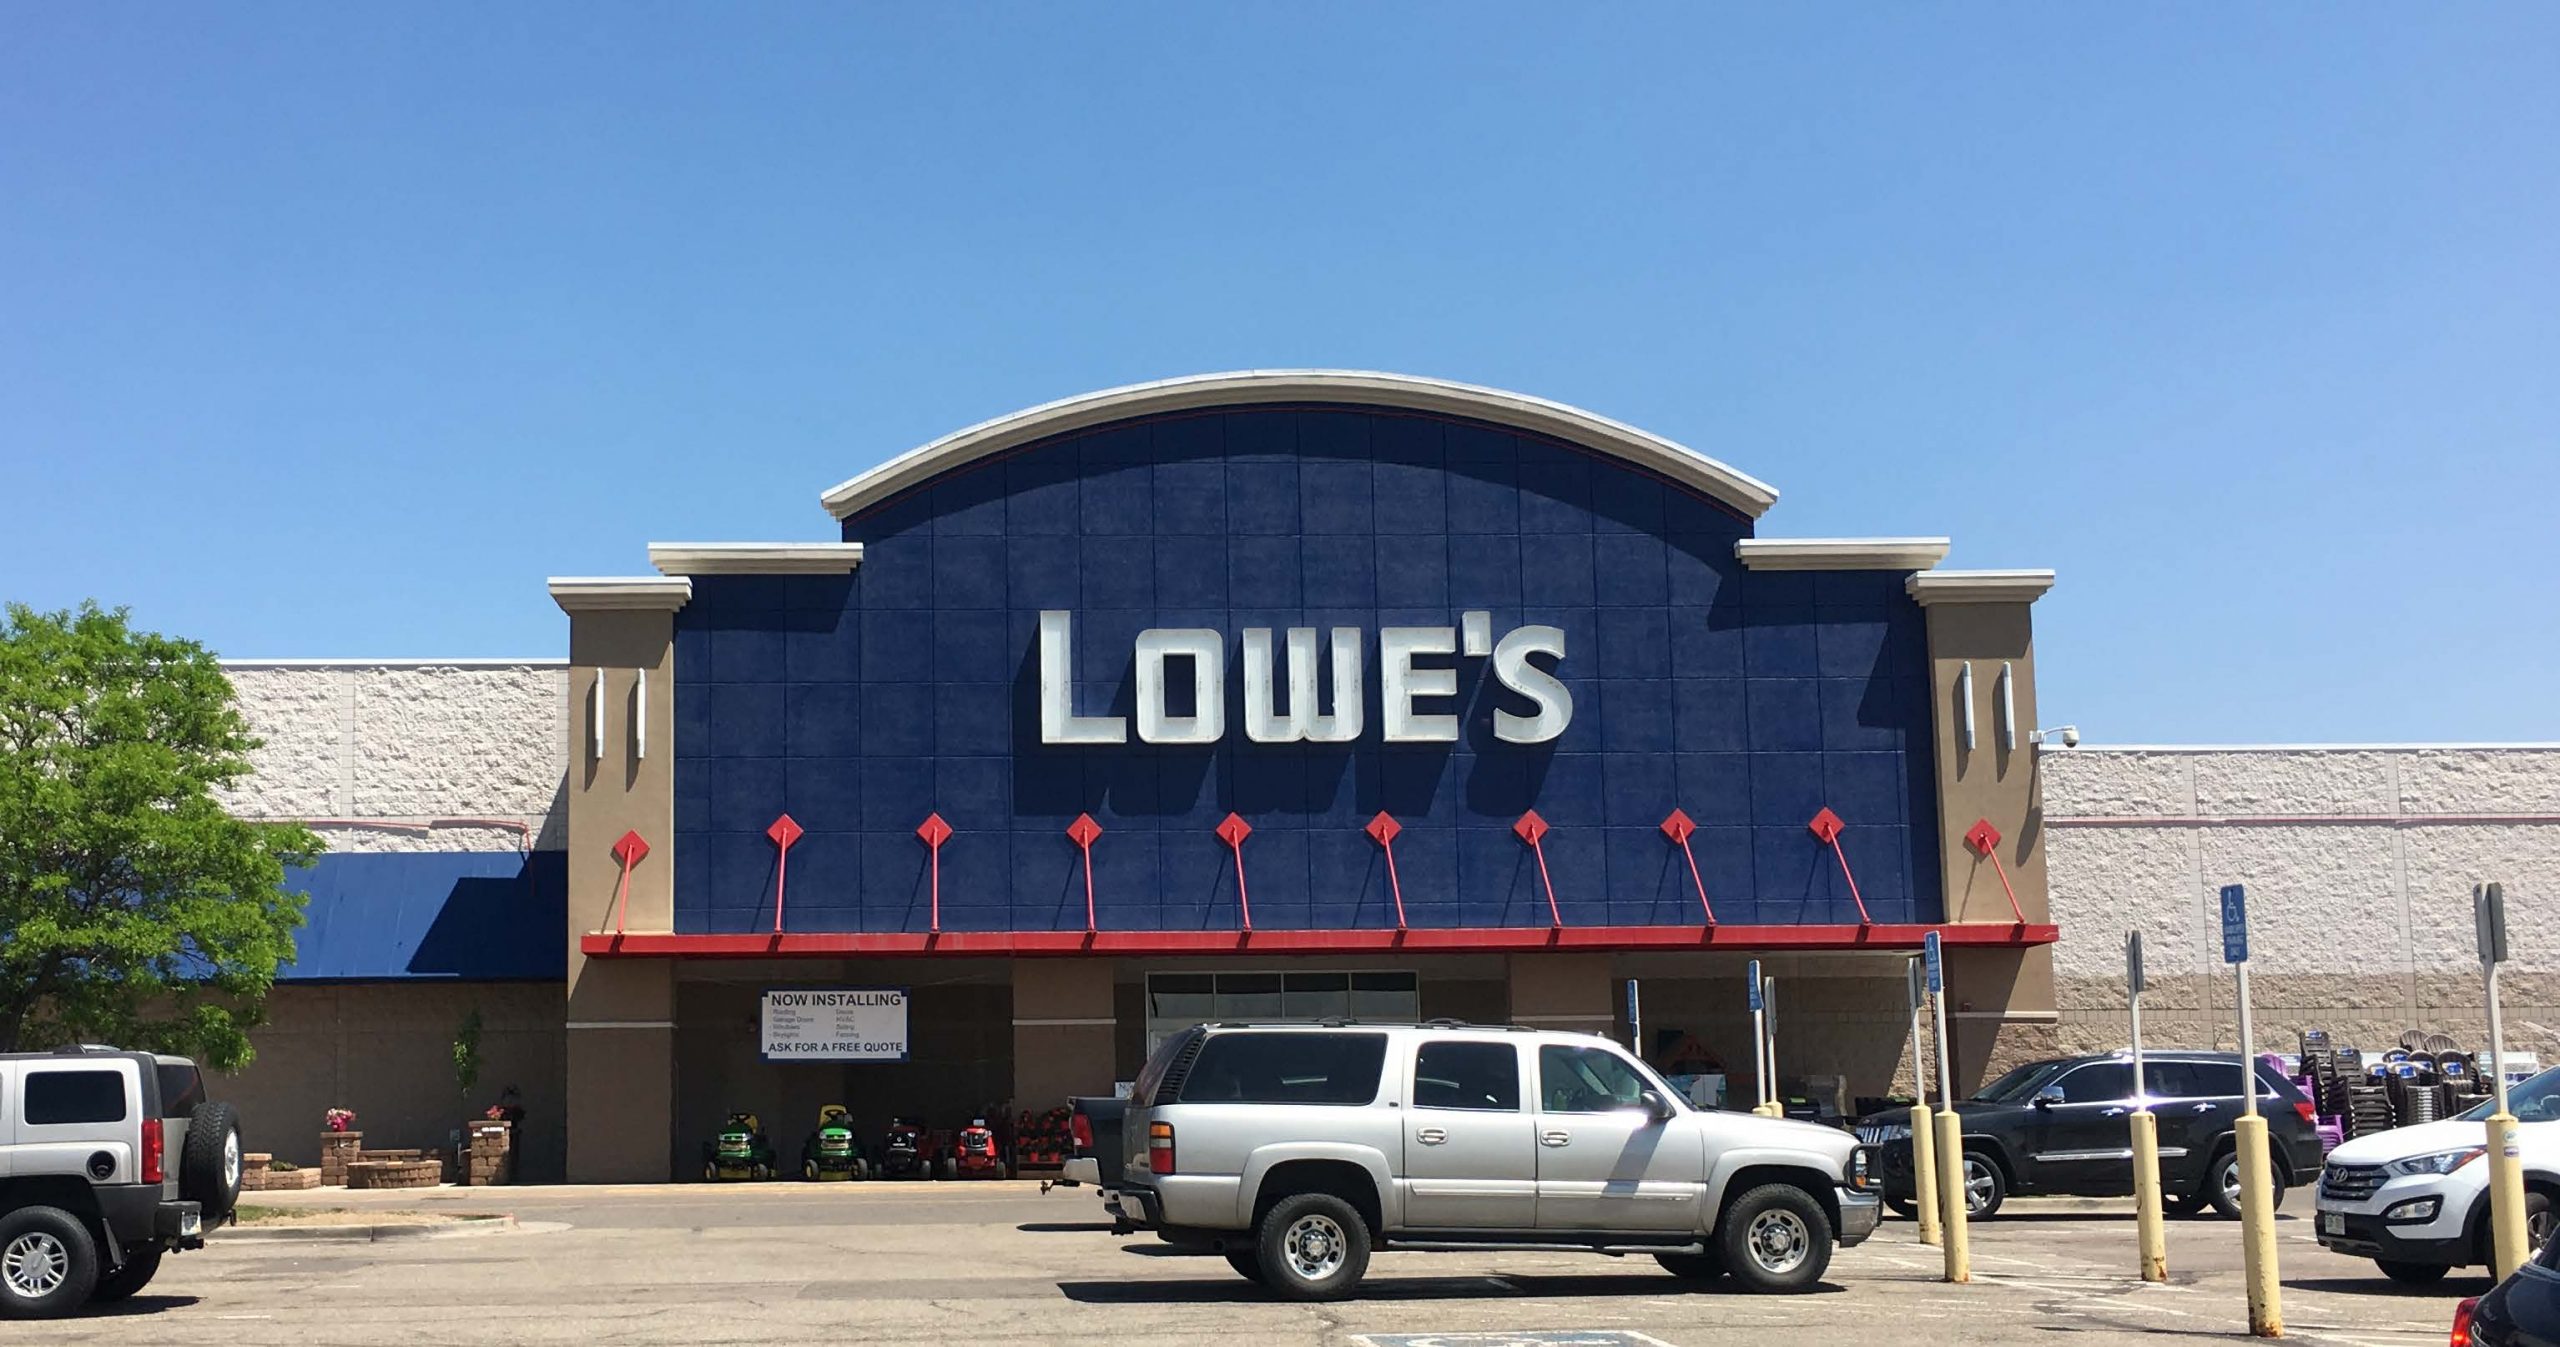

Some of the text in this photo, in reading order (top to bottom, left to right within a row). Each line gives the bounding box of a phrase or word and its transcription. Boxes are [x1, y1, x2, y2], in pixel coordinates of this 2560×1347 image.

[1040, 609, 1574, 744] LOWE'S
[771, 993, 901, 1006] NOW INSTALLING
[768, 1042, 902, 1052] ASK FOR A FREE QUOTE
